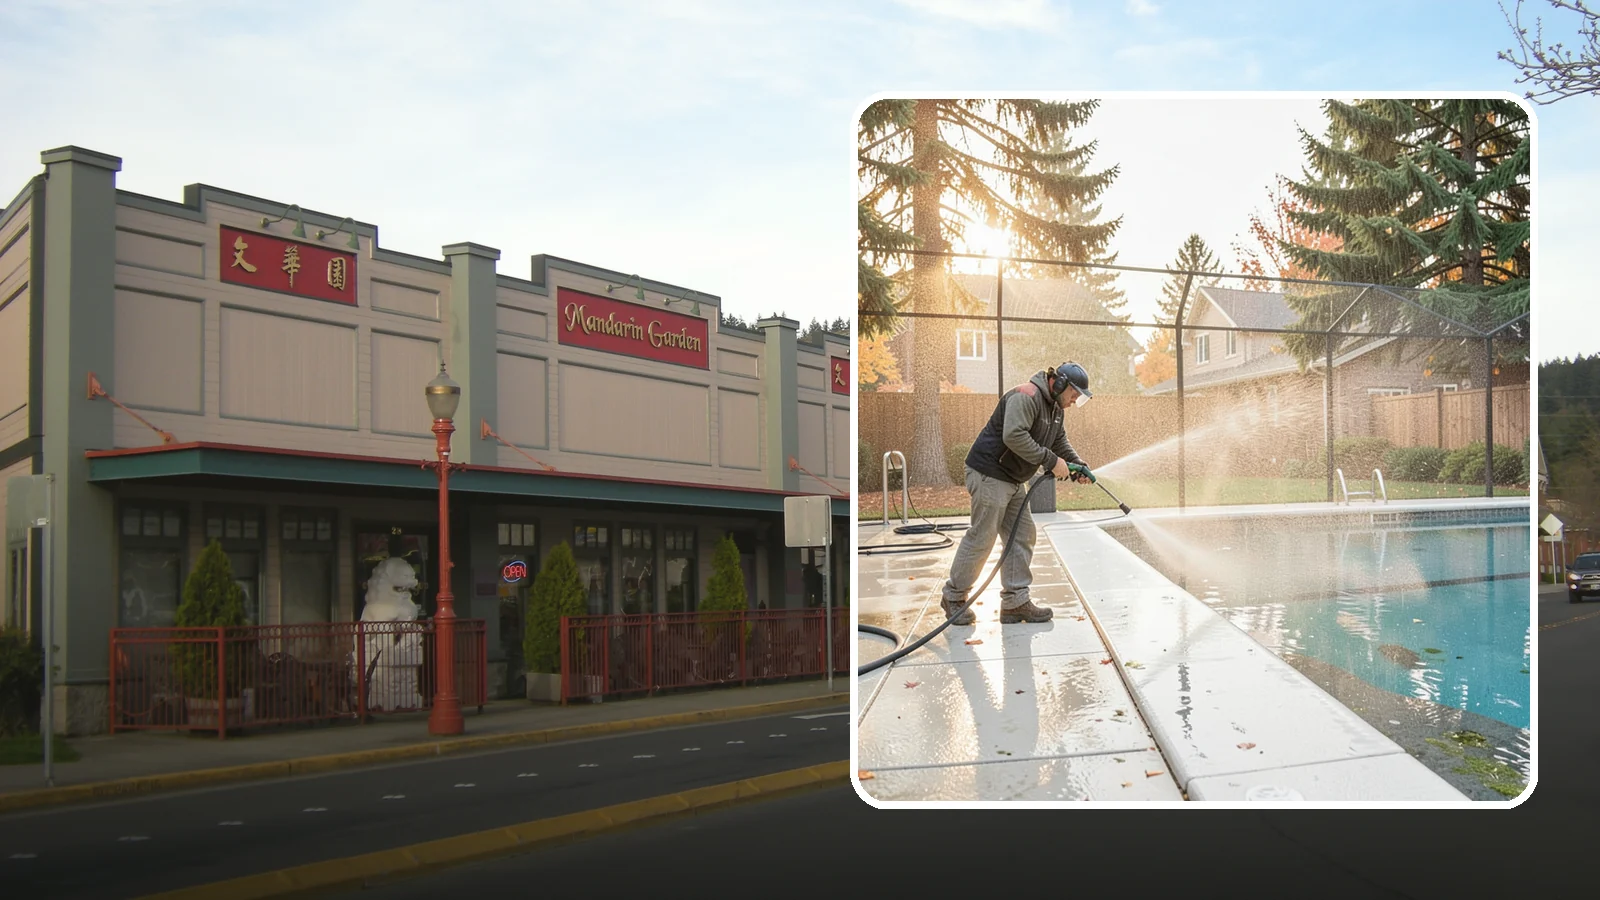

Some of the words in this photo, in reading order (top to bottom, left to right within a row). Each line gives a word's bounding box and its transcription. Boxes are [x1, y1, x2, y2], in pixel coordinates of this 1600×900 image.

[230, 235, 346, 291] 文華園
[564, 302, 644, 341] Mandarin
[648, 320, 702, 352] Garden
[503, 565, 527, 578] OPEN
